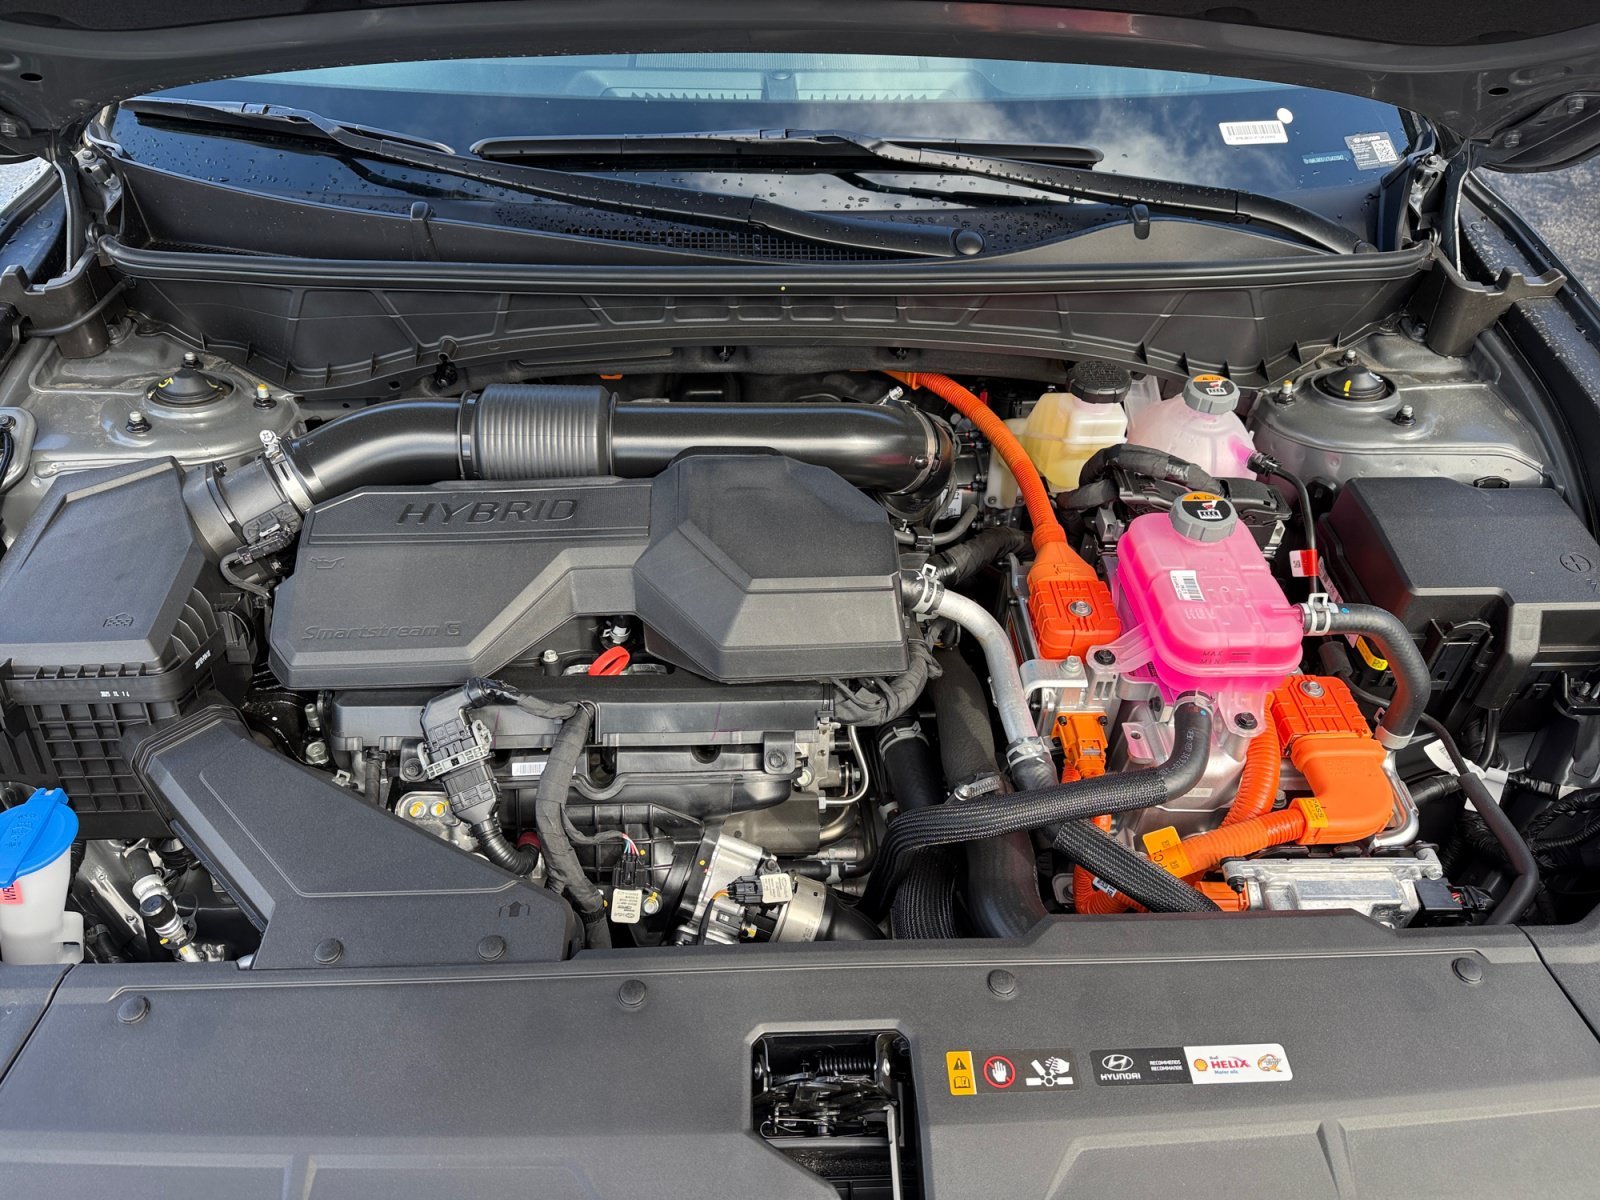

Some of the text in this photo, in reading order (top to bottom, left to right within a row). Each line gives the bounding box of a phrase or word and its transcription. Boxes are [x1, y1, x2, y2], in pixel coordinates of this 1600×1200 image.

[396, 500, 577, 525] HYBRID
[302, 624, 440, 641] Smartstream
[1210, 1059, 1250, 1069] HELIX
[1100, 1072, 1142, 1081] HYUNDAI
